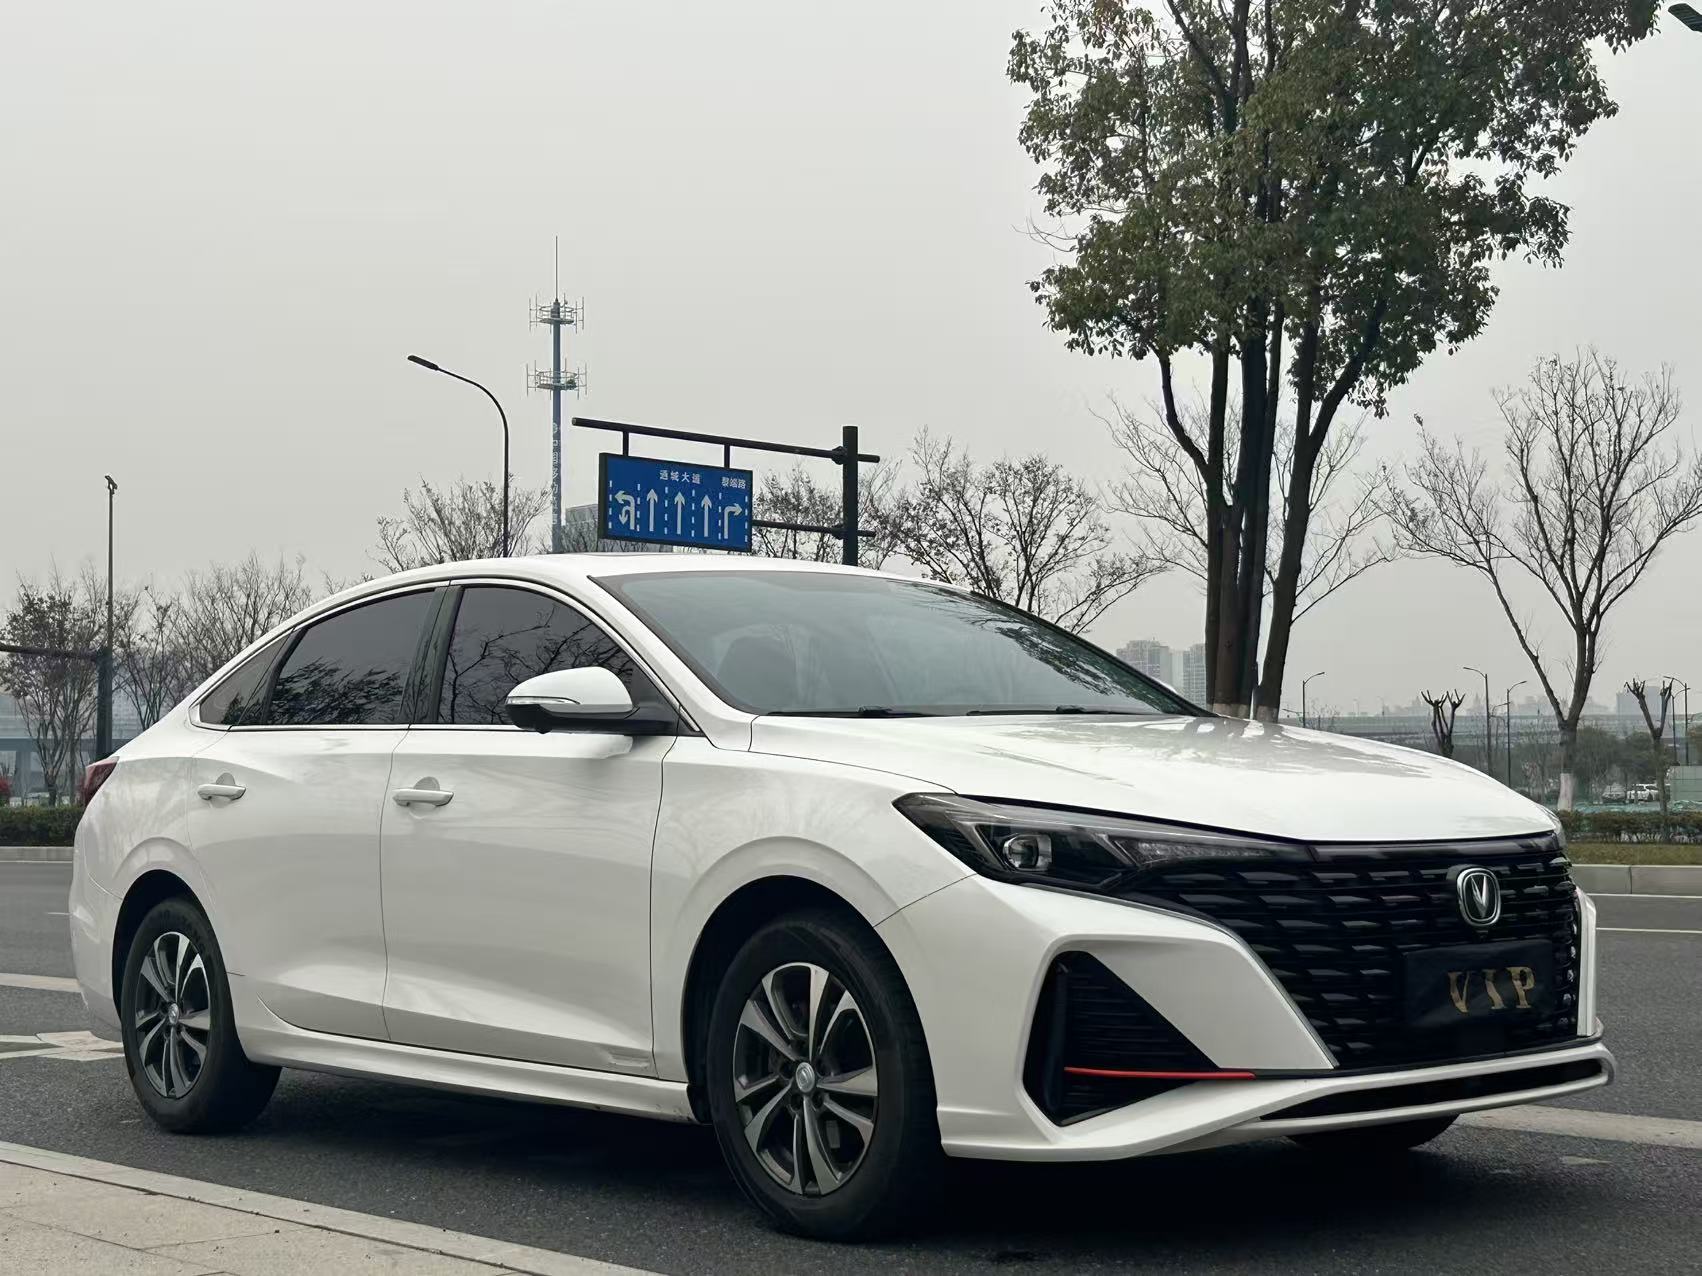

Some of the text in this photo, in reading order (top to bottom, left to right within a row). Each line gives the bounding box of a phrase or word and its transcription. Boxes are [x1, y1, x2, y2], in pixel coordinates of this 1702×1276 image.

[659, 469, 701, 485] 通城大道
[1447, 966, 1536, 1013] VIP
